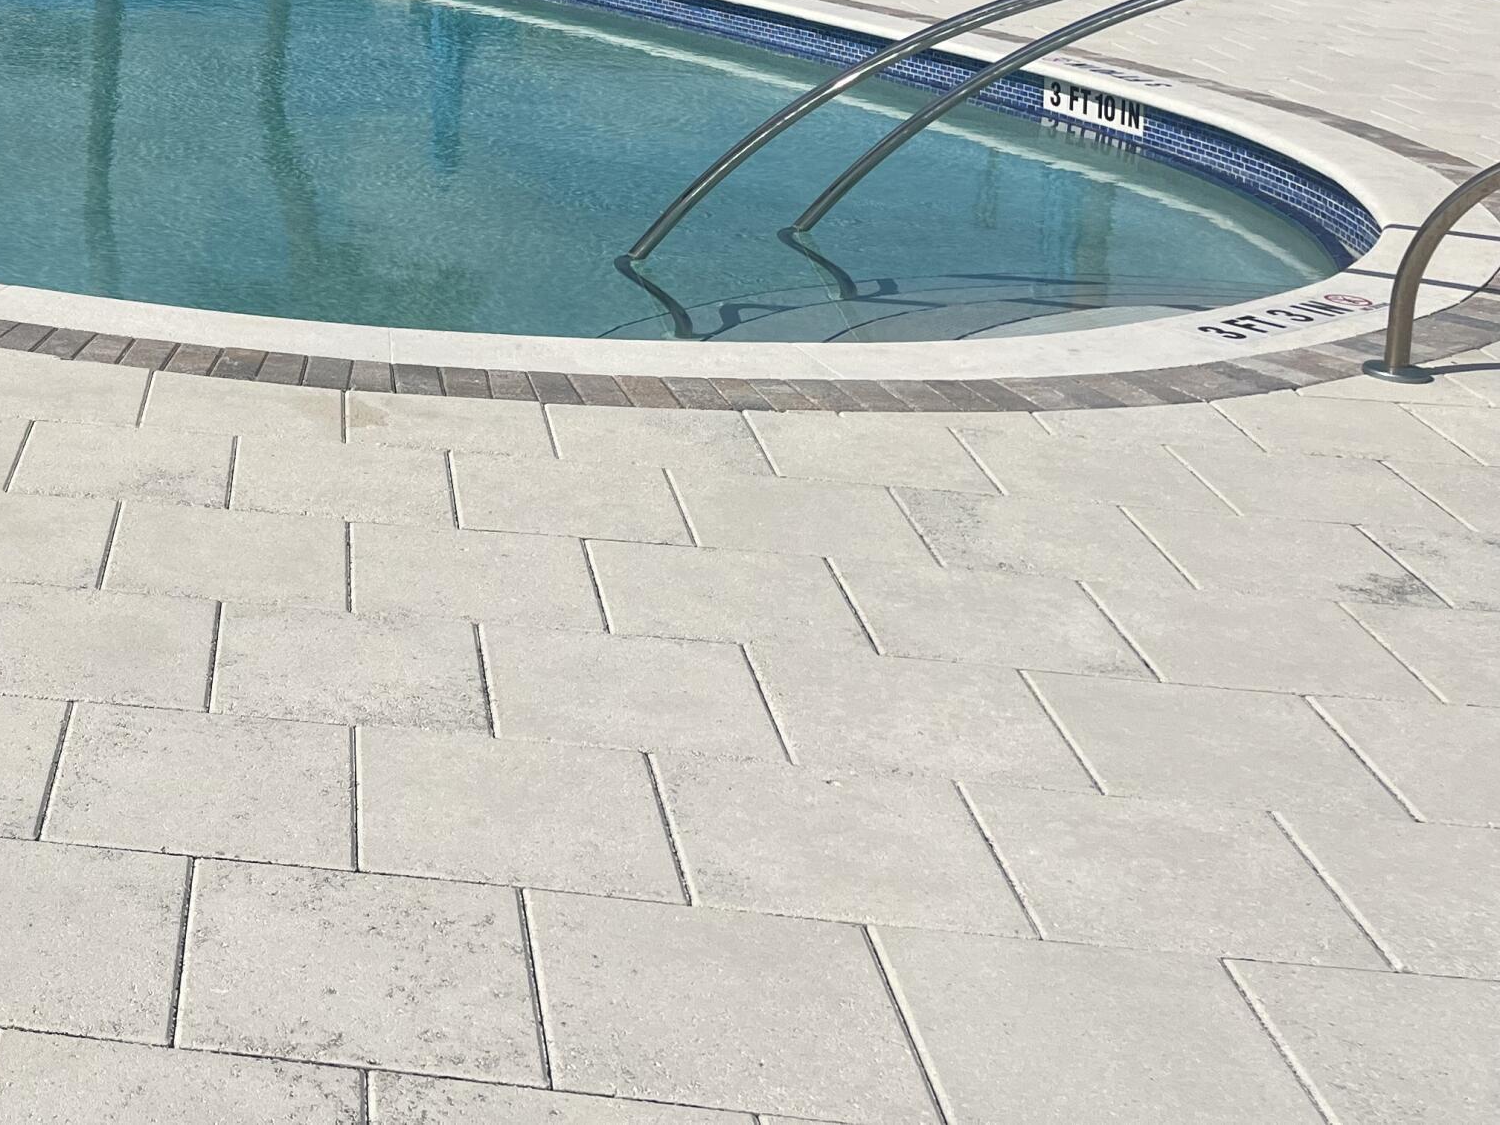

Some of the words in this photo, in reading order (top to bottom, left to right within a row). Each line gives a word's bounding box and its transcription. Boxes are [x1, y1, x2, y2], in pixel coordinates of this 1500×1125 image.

[1050, 81, 1061, 107] 3
[1069, 85, 1091, 115] FT
[1095, 93, 1116, 122] 10
[1121, 99, 1141, 129] IN
[1266, 309, 1314, 322] 3
[1289, 300, 1354, 317] IN
[1198, 326, 1247, 340] 3
[1221, 315, 1287, 334] FT
